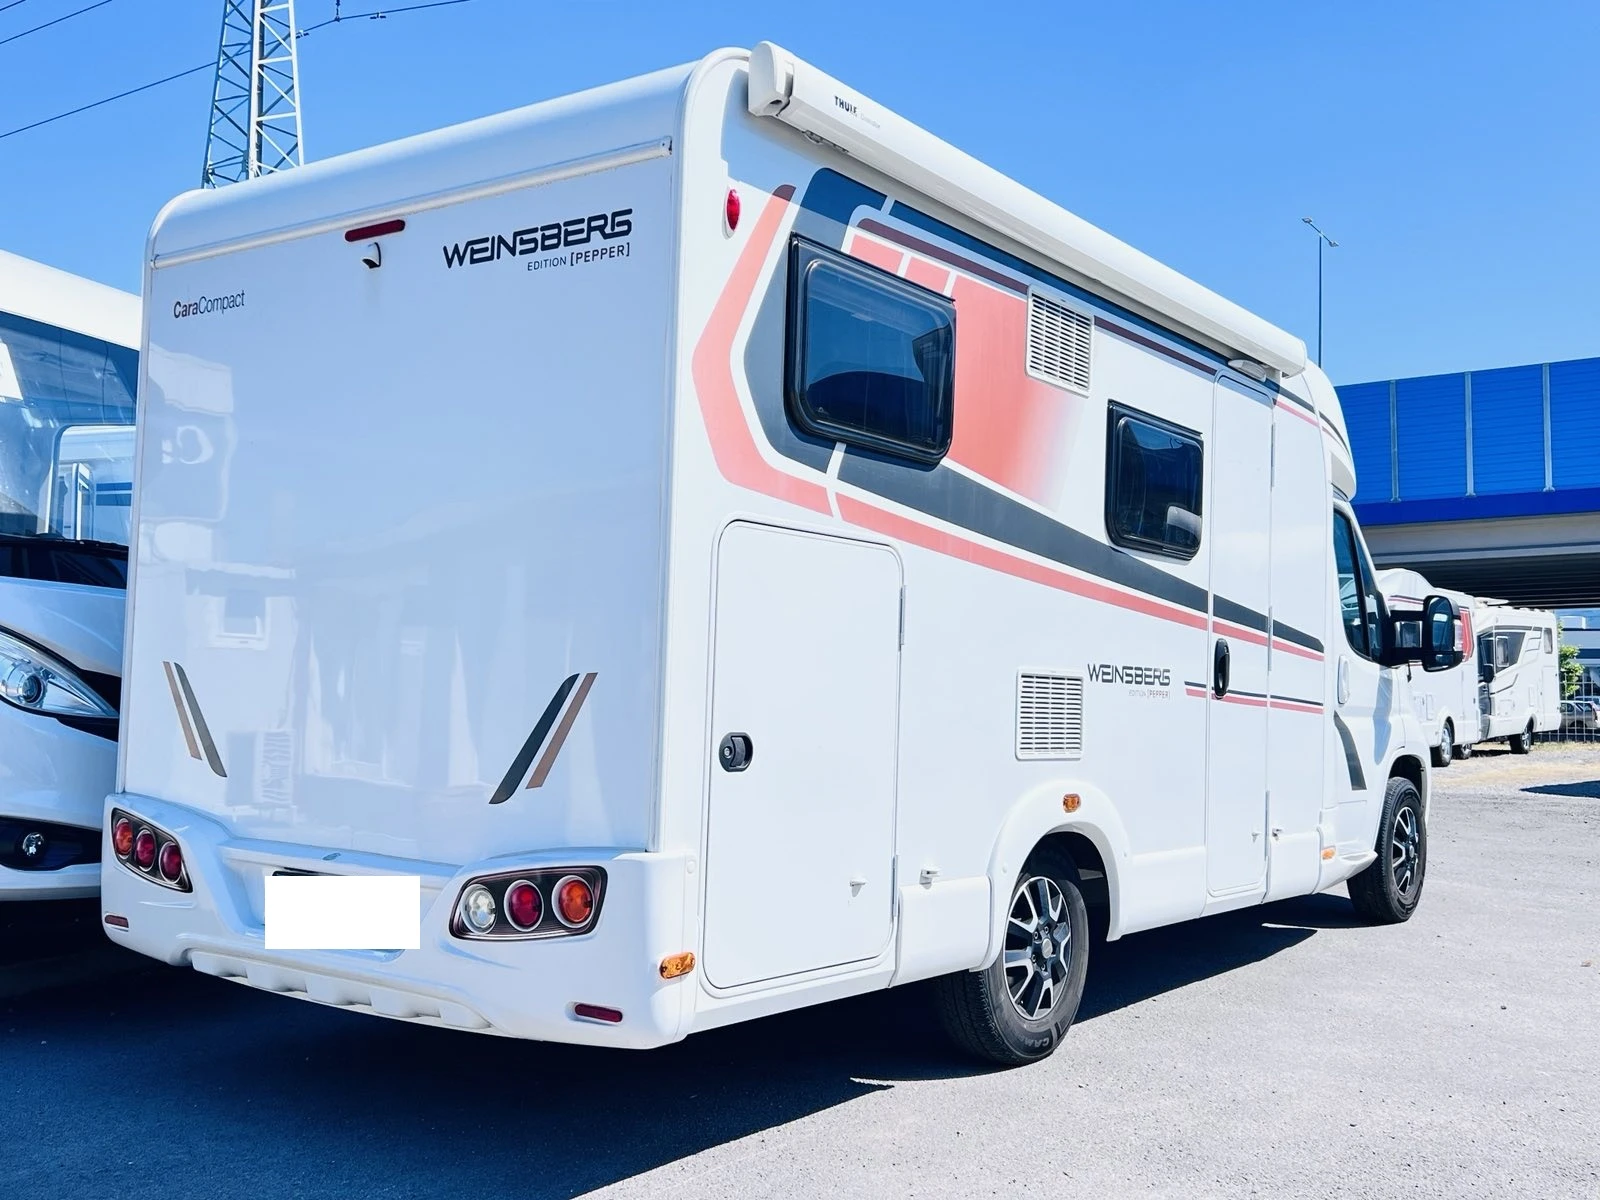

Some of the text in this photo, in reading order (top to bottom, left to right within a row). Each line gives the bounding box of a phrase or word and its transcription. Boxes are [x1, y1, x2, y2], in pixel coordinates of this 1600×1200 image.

[443, 208, 633, 269] WEINSBERG
[527, 242, 630, 271] EDITION [PEPPER]
[173, 290, 245, 319] CaraCompact
[1087, 663, 1171, 686] WEINSBERG
